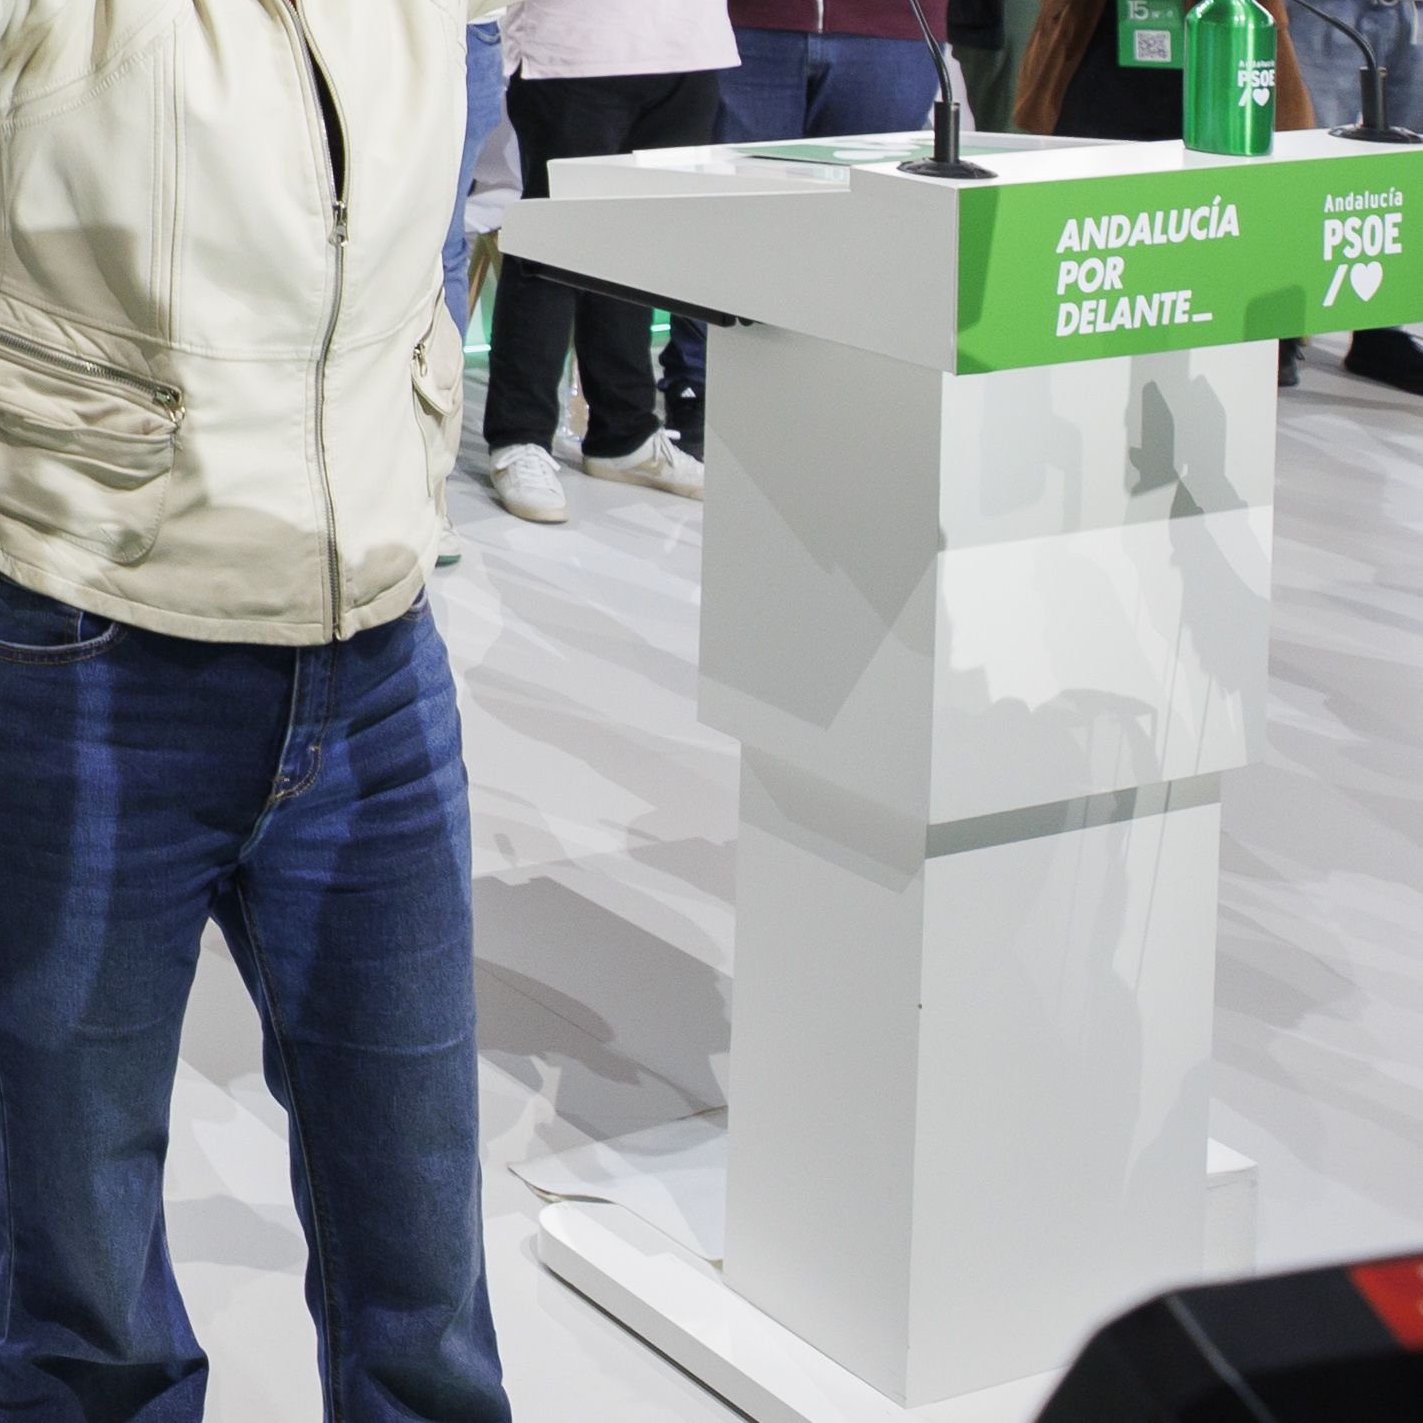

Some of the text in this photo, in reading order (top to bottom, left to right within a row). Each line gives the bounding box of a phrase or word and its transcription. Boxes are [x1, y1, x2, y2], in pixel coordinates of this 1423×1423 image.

[1127, 0, 1149, 20] 15
[1237, 69, 1276, 88] PSOE
[1323, 187, 1404, 213] Andalucía
[1056, 195, 1240, 253] ANDALUCÍA
[1322, 212, 1403, 261] PSOE
[1057, 256, 1125, 295] POR
